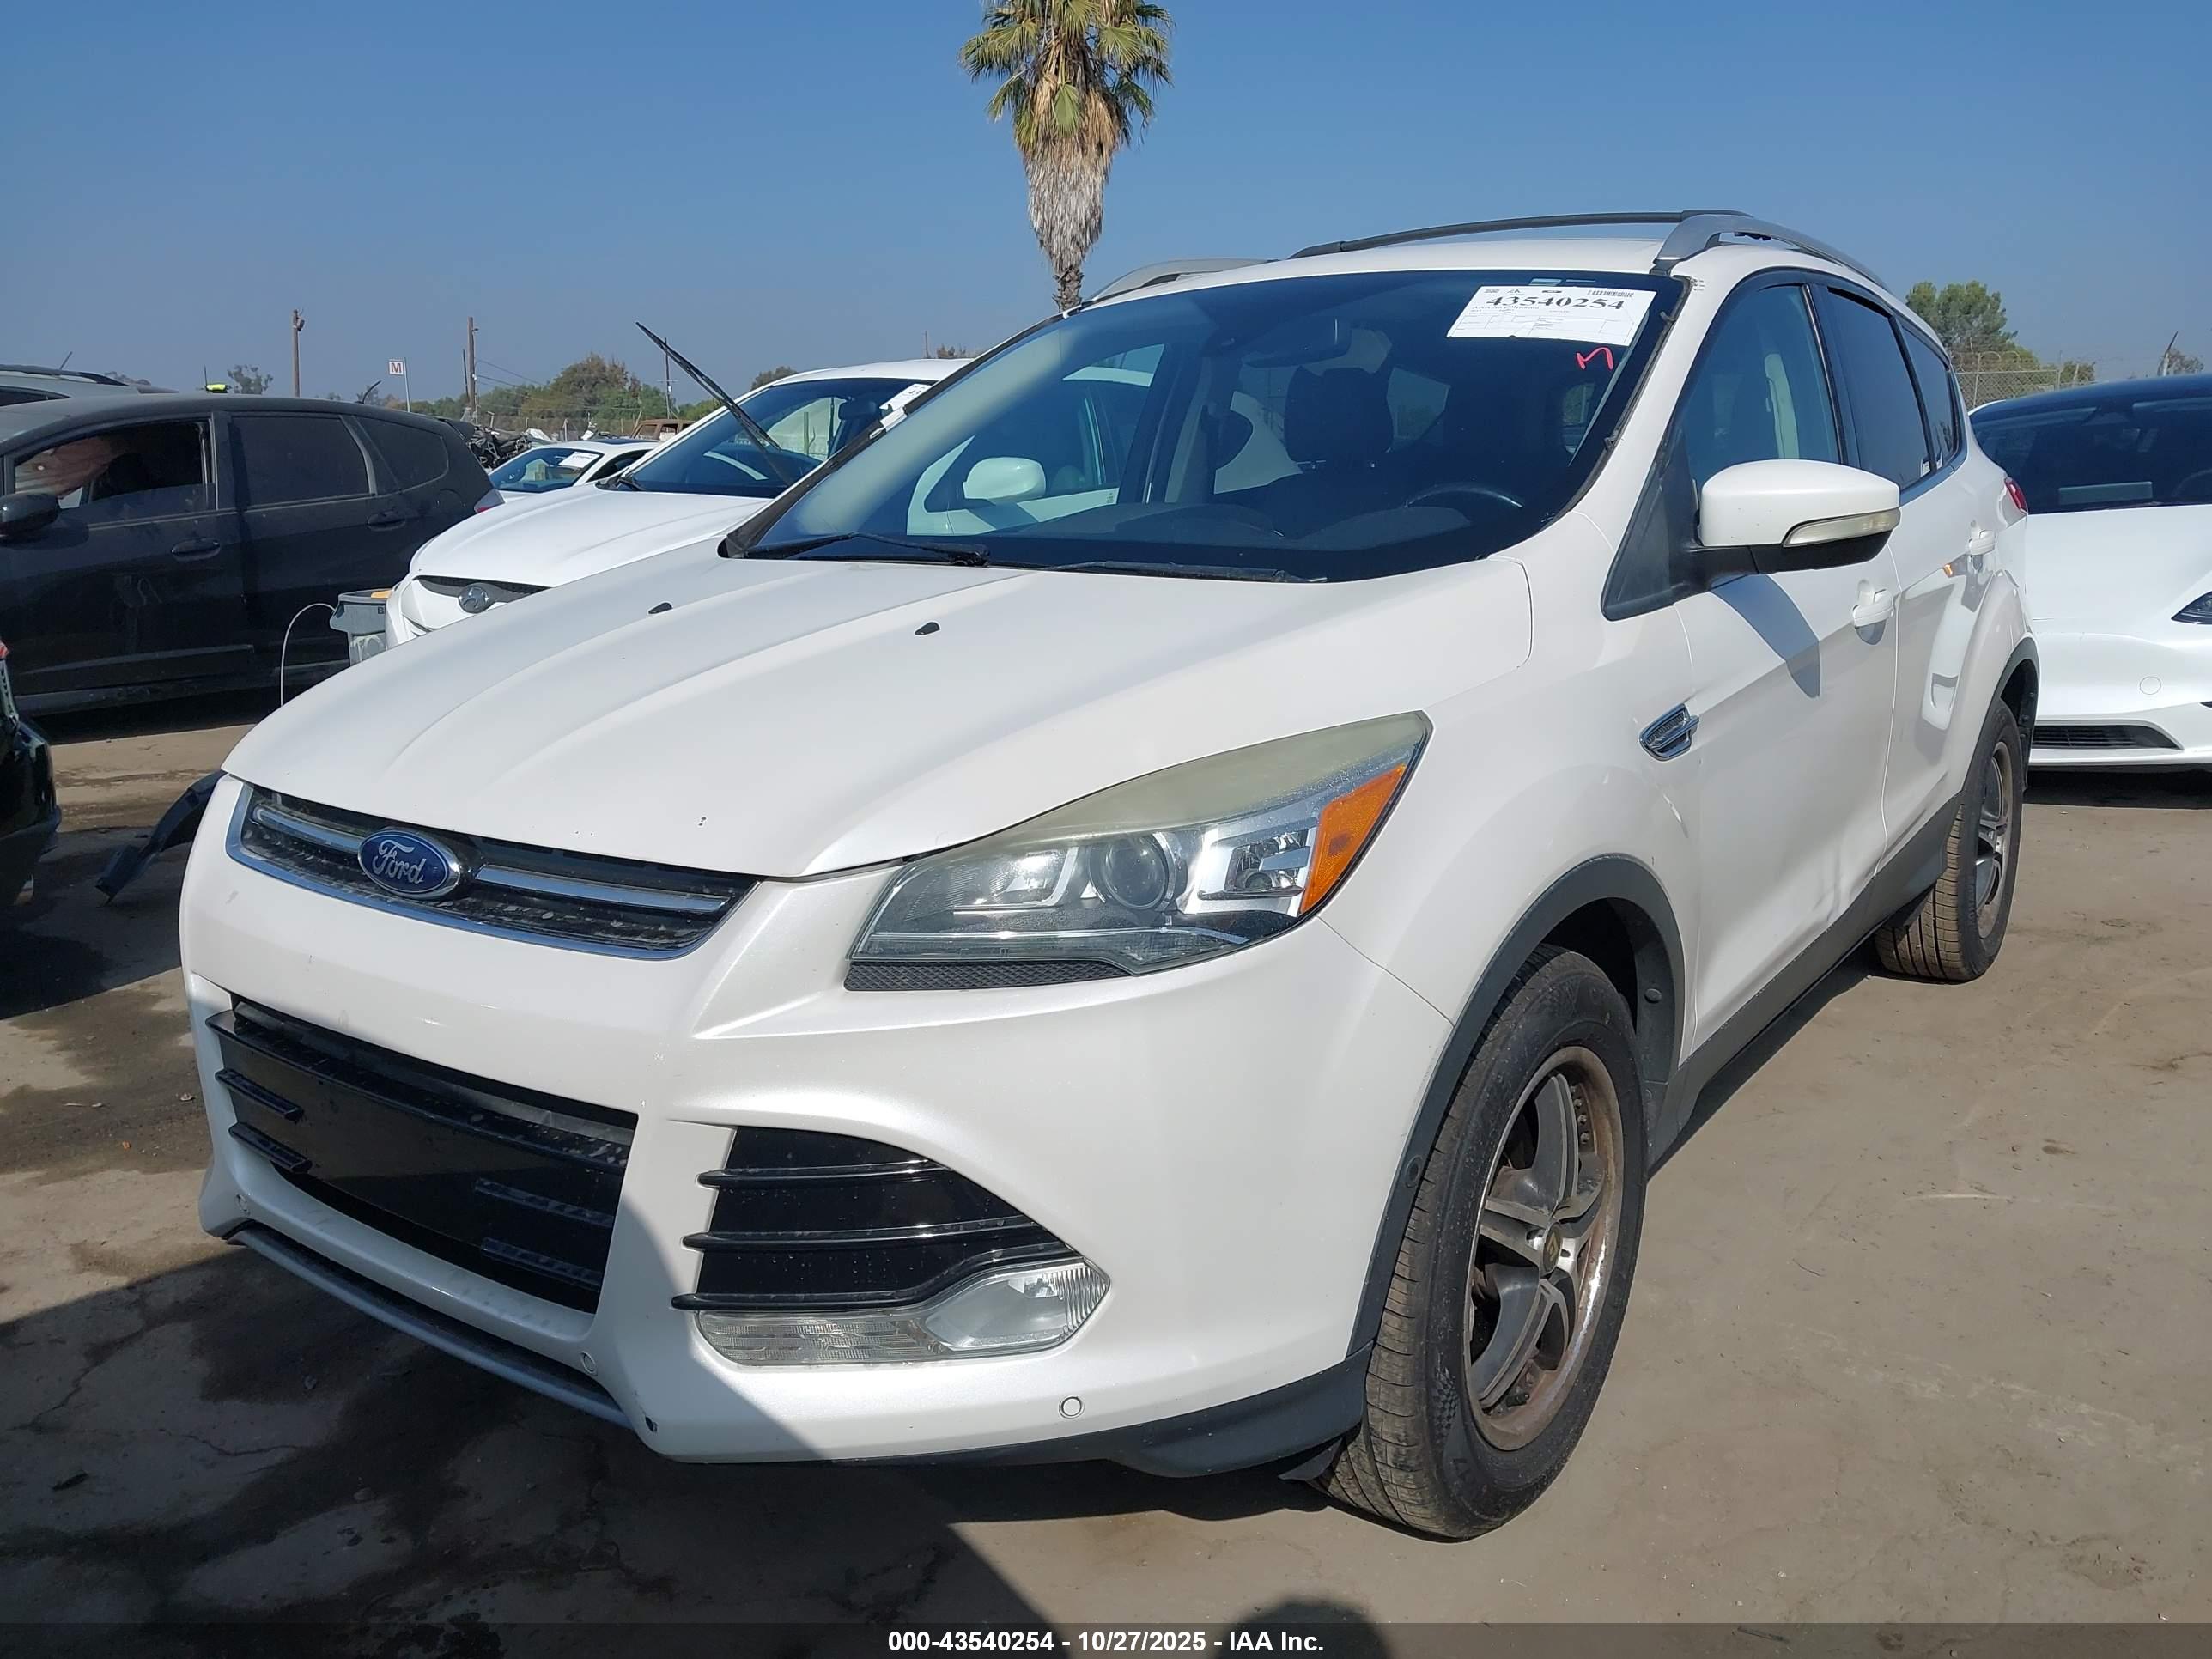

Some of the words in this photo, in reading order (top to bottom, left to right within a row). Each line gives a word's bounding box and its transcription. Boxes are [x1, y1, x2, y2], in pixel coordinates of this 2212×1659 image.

[1486, 295, 1625, 310] 43540254
[391, 362, 402, 373] M
[372, 839, 427, 884] Ford
